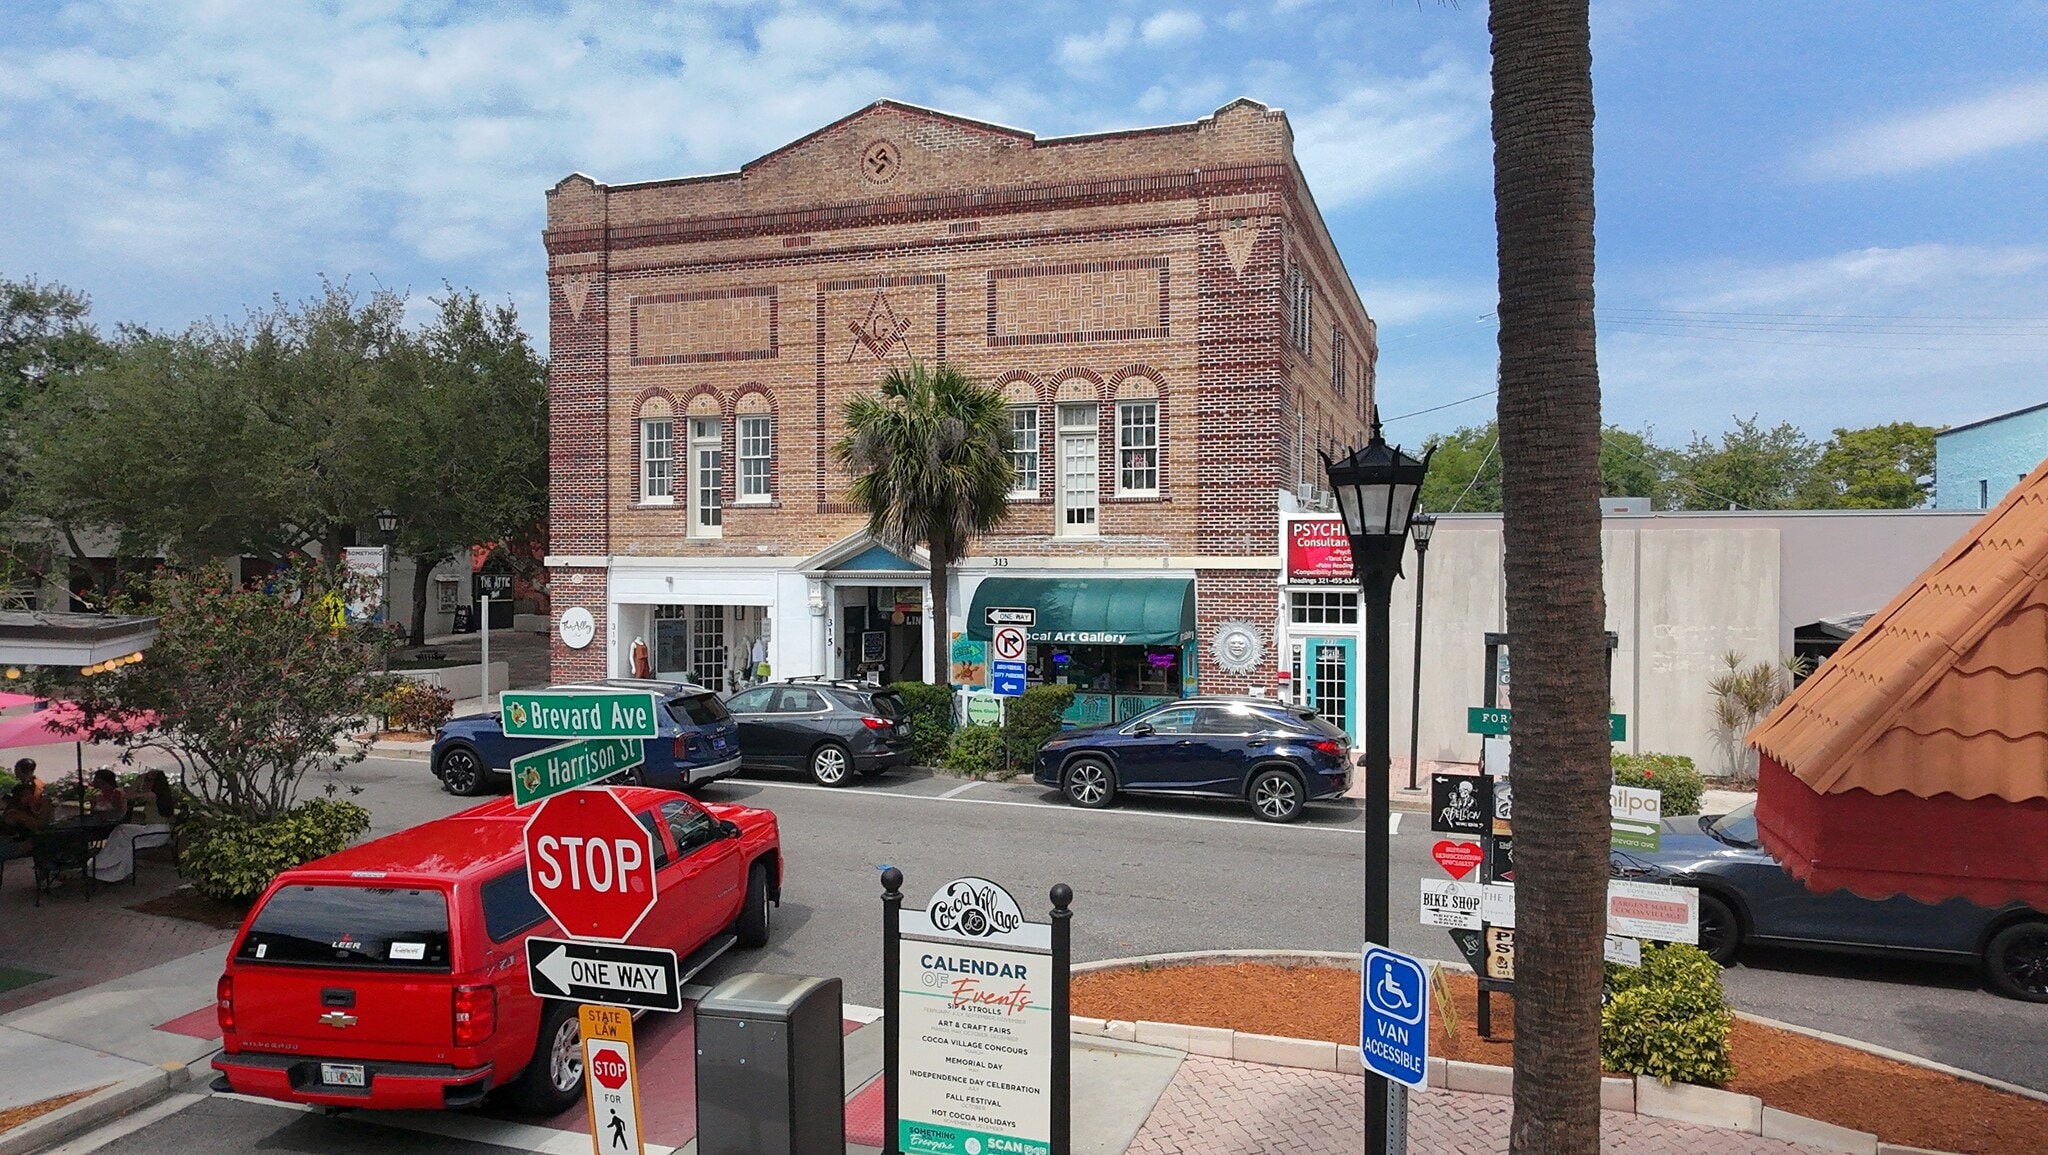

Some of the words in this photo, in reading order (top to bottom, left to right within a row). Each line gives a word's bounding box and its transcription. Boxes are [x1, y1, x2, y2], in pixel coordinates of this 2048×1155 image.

[1294, 523, 1345, 537] PSYCHI
[993, 557, 1008, 567] 313
[1000, 612, 1013, 620] ONE
[1025, 631, 1051, 641] ocal
[1054, 631, 1076, 642] Art
[1079, 631, 1127, 645] Gallery
[530, 701, 602, 730] Brevard
[611, 701, 647, 730] Ave
[547, 745, 616, 788] Harrison
[620, 738, 636, 762] St
[537, 834, 643, 893] STOP
[1422, 892, 1448, 907] BIKE
[1452, 895, 1480, 910] SHOP
[1484, 892, 1503, 903] THE
[930, 890, 971, 931] Cocoa
[960, 881, 1020, 935] Village
[1612, 900, 1650, 909] LARGEST
[1652, 904, 1673, 912] MALL
[332, 940, 362, 950] LEER
[921, 954, 1027, 980] CALENDAR
[571, 960, 611, 986] ONE
[617, 965, 660, 990] WAY
[921, 971, 949, 988] OF
[951, 977, 1034, 1016] Events
[588, 1009, 622, 1024] STATE
[947, 1002, 958, 1010] SIP
[967, 1005, 1002, 1016] STROLLS
[595, 1023, 617, 1037] LAW
[938, 1019, 953, 1028] ART
[962, 1023, 987, 1032] CRAFT
[989, 1027, 1012, 1035] FAIRS
[1377, 1018, 1409, 1046] VAN
[922, 1035, 949, 1045] COCOA
[951, 1039, 983, 1050] VILLAGE
[984, 1043, 1029, 1056] CONCOURS
[1364, 1036, 1422, 1074] ACCESSIBLE
[594, 1061, 625, 1078] STOP
[945, 1056, 986, 1068] MEMORIAL
[987, 1062, 1003, 1071] DAY
[909, 1069, 968, 1084] INDEPENDENCE
[969, 1077, 985, 1087] DAY
[986, 1080, 1041, 1095] CELEBRATION
[604, 1093, 621, 1104] FOR
[945, 1092, 965, 1102] FALL
[966, 1095, 1002, 1107] FESTIVAL
[931, 1108, 947, 1118] HOT
[949, 1111, 977, 1122] COCOA
[978, 1115, 1016, 1128] HOLIDAYS
[909, 1126, 956, 1140] SOMETHING
[987, 1138, 1023, 1153] SCAN
